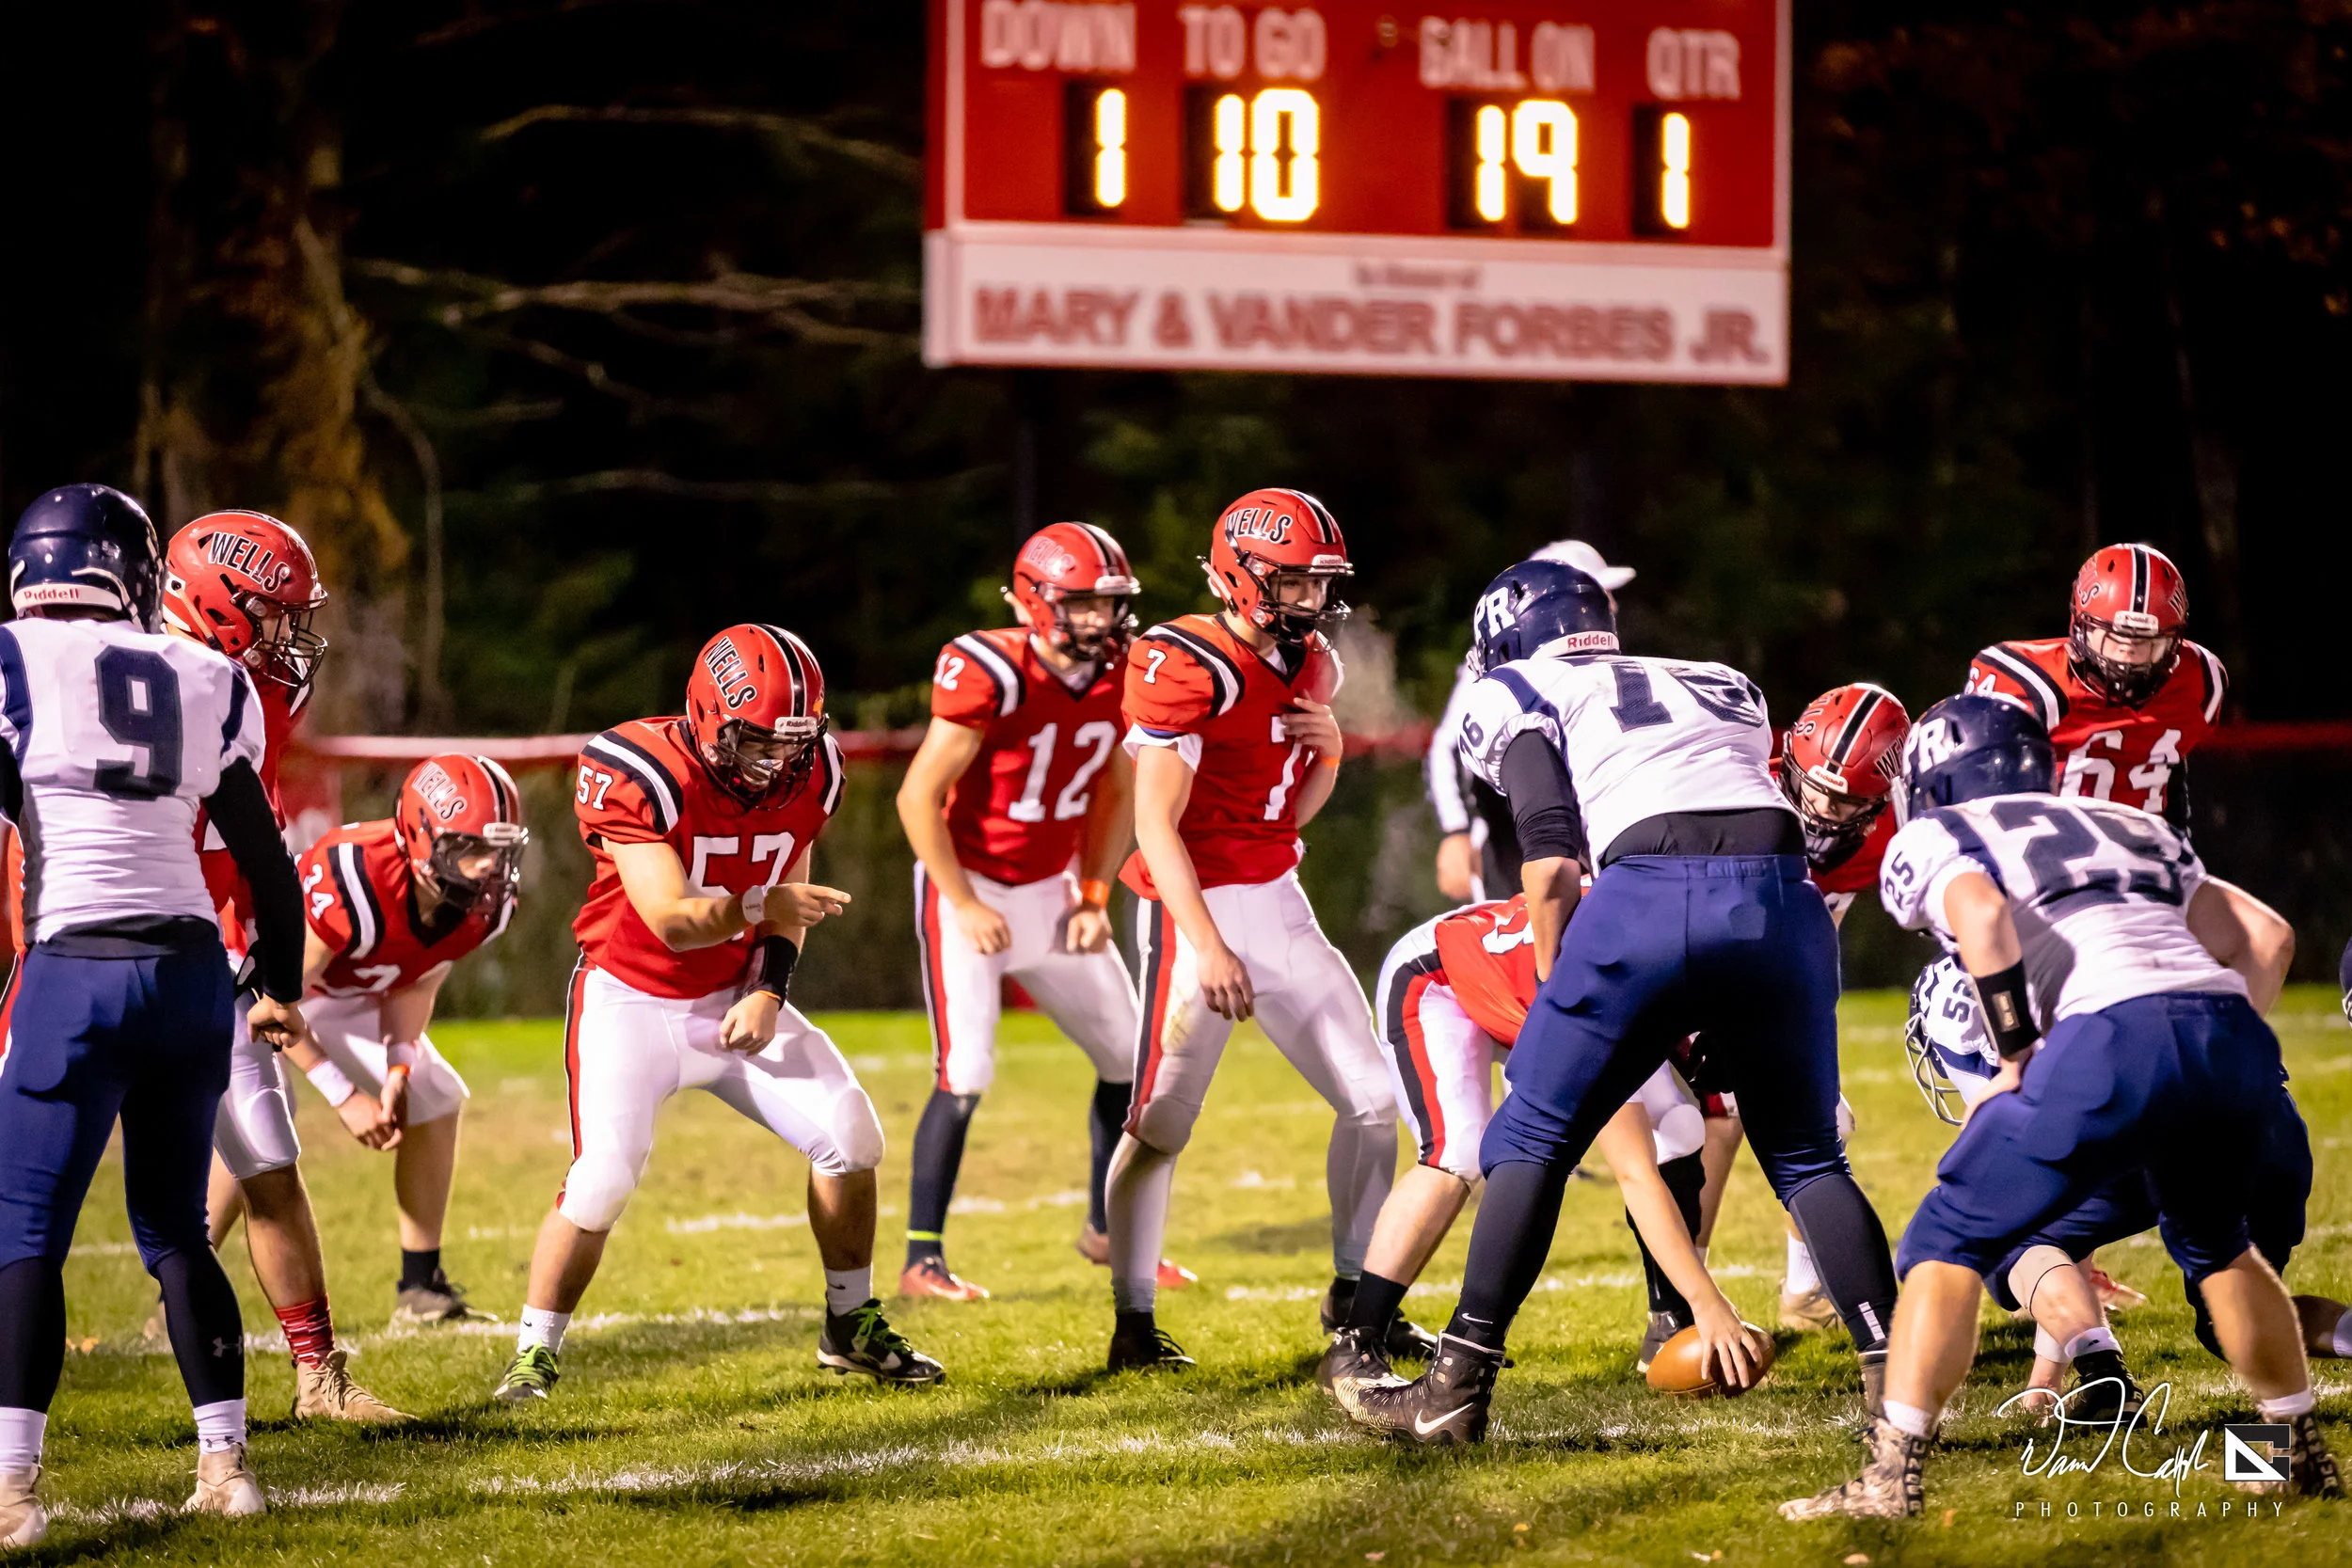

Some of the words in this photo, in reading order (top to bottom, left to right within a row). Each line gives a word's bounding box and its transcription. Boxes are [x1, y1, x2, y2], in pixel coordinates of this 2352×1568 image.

[981, 0, 1136, 71] DOWN
[1178, 6, 1245, 77] TO
[1254, 8, 1326, 80] GO
[1419, 16, 1527, 89] BALL
[1532, 21, 1596, 91] ON
[1646, 26, 1741, 101] QTR
[1095, 88, 1126, 207] 1
[1214, 88, 1319, 222] 10
[1476, 99, 1578, 224] 19
[1661, 112, 1690, 229] 1
[975, 288, 1136, 345] MARY
[1153, 291, 1192, 348] &
[1206, 293, 1436, 355] VANDER
[1454, 303, 1673, 362] FORBES
[208, 531, 291, 593] WELLS
[1225, 508, 1293, 544] WELLS
[24, 589, 79, 600] Riddell
[1474, 587, 1516, 639] PR
[705, 636, 756, 709] WELLS
[934, 653, 965, 690] 12
[1143, 649, 1168, 684] 7
[1567, 634, 1613, 648] Riddell
[94, 644, 183, 801] 9
[1902, 718, 1949, 776] PR
[411, 761, 468, 823] WELLS
[577, 765, 613, 811] 57
[1008, 721, 1117, 822] 12
[2060, 729, 2181, 814] 64
[684, 832, 795, 898] 57
[1990, 800, 2193, 915] 25
